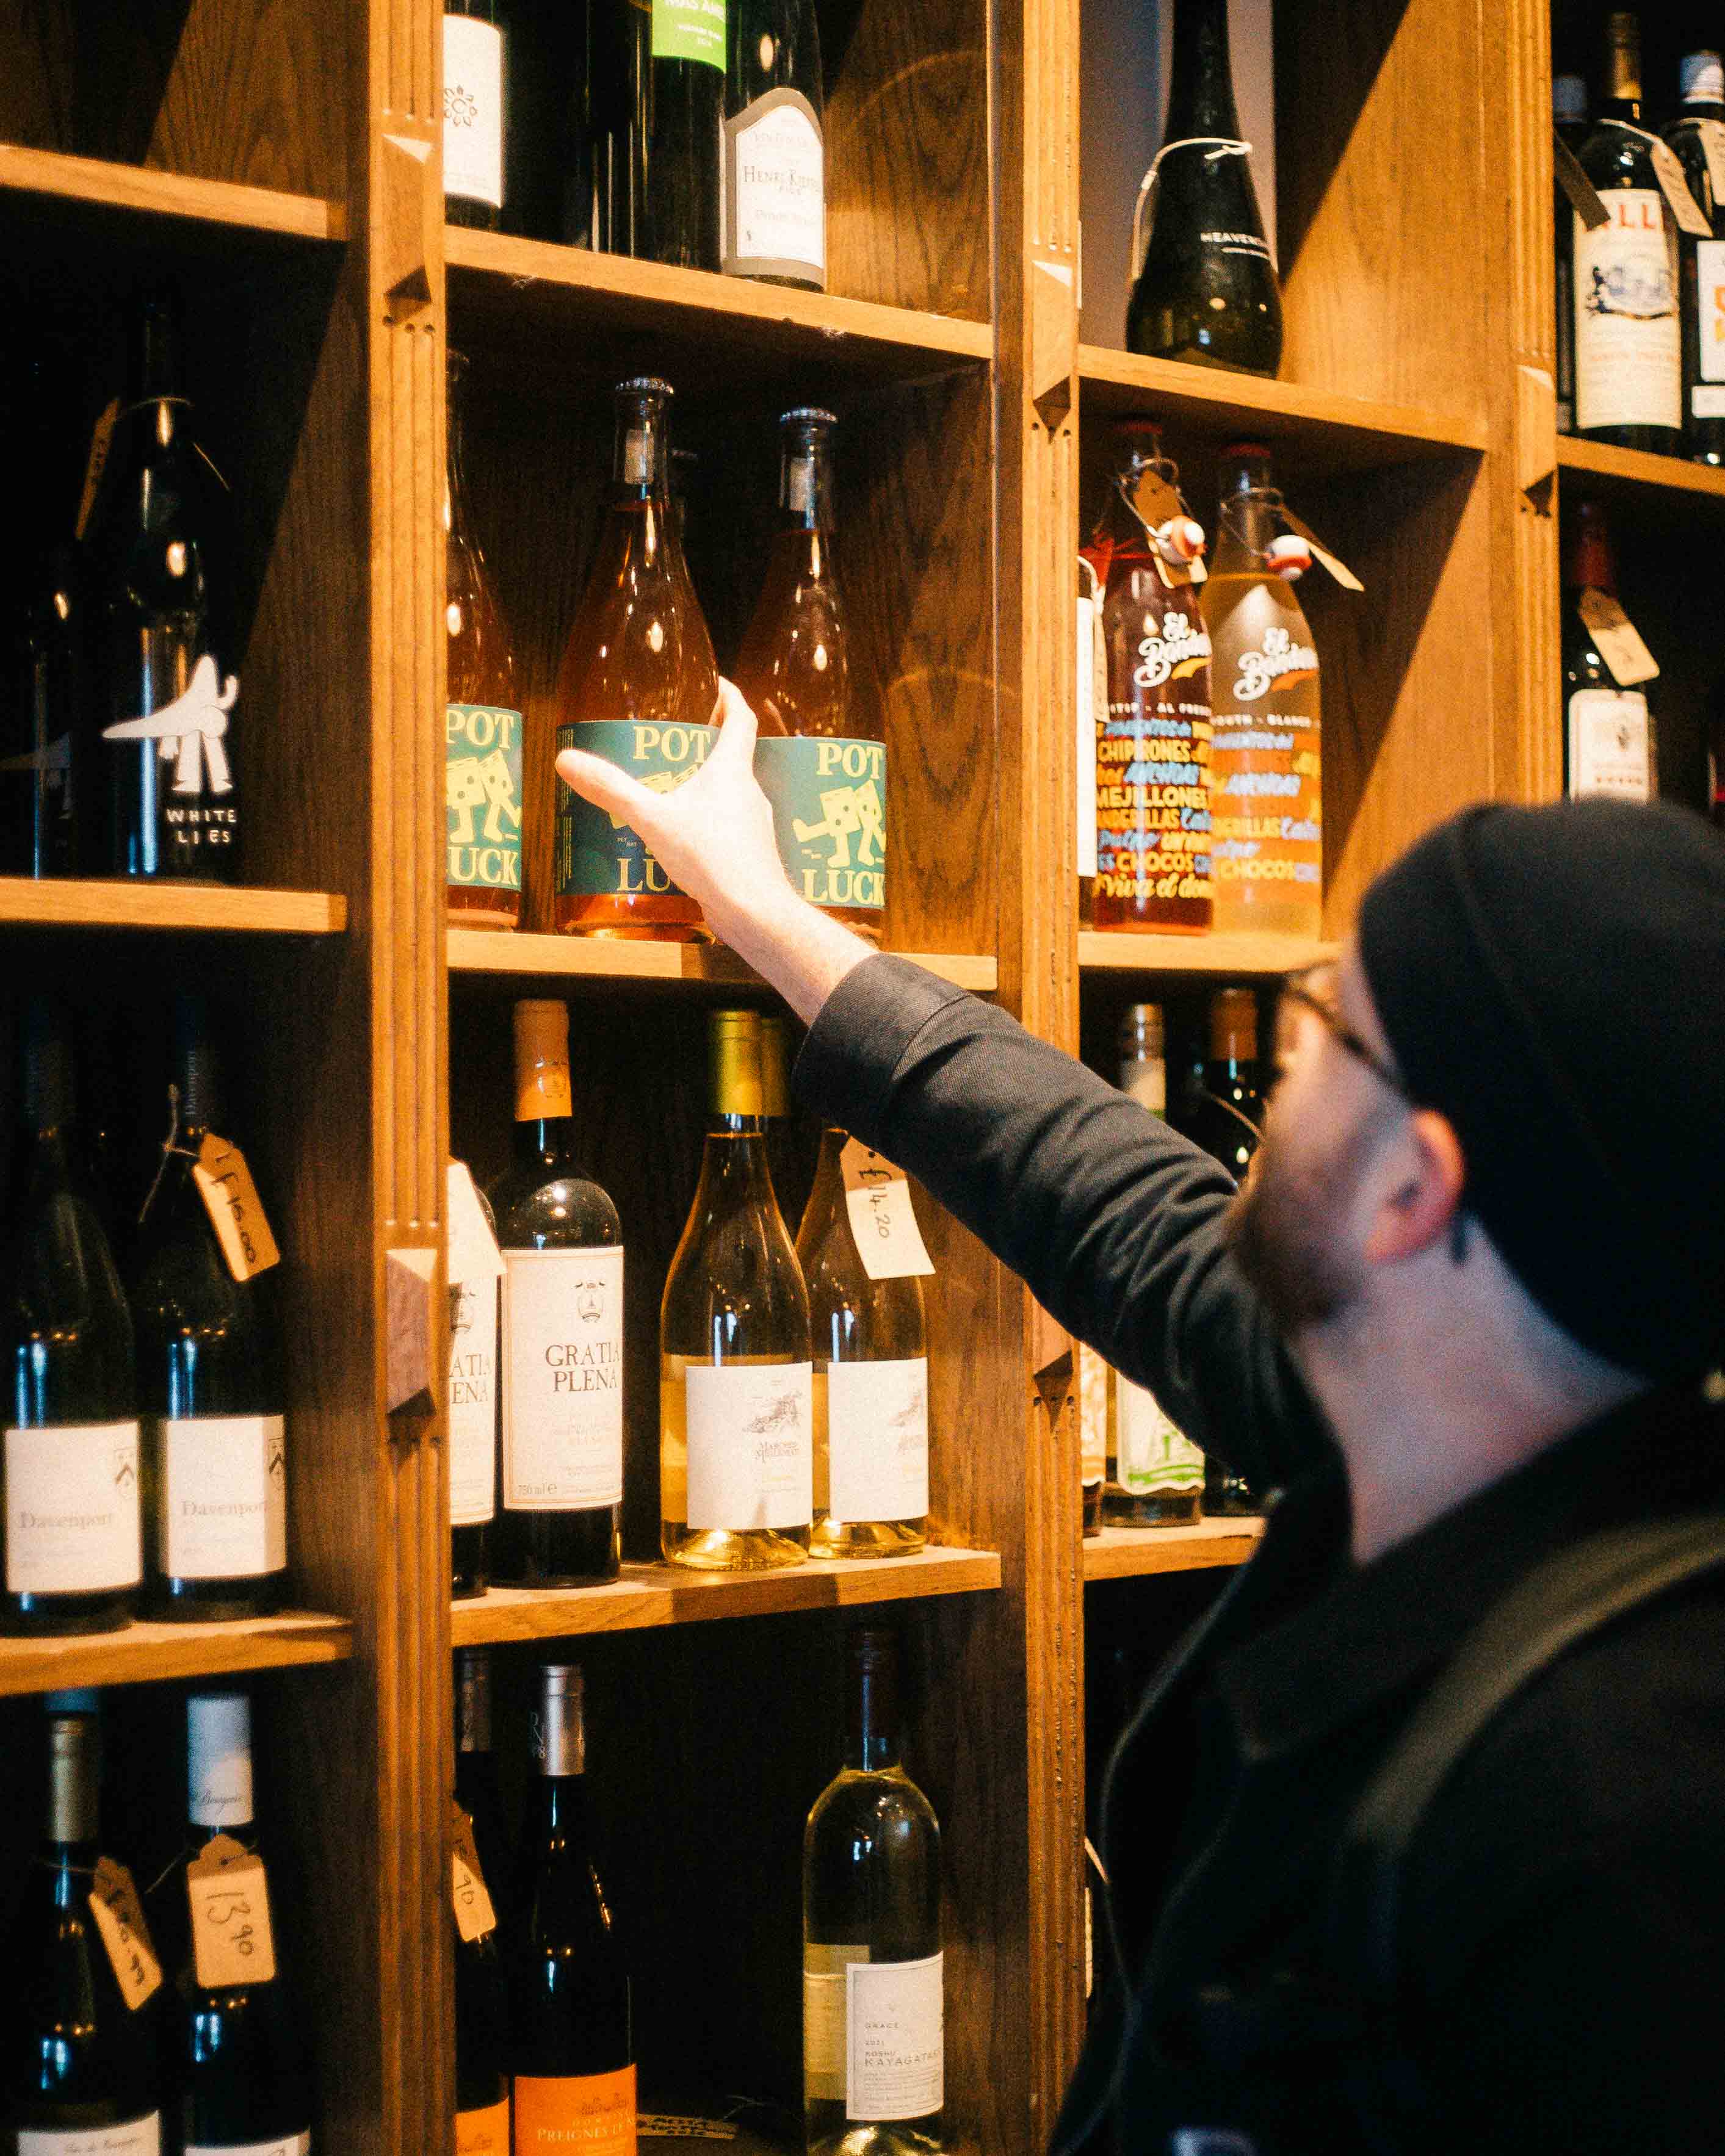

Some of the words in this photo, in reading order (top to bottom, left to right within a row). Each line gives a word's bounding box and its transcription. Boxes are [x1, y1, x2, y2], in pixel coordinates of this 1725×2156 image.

[446, 711, 514, 750] POT
[633, 726, 713, 763] POT
[816, 743, 883, 779] POT
[166, 809, 237, 823] WHITE
[177, 829, 231, 845] LIES
[447, 846, 518, 886] UCK
[617, 857, 671, 892] LU
[801, 868, 885, 906] LUCK
[859, 1168, 892, 1239] £14.20
[545, 1343, 621, 1367] GRATIA
[554, 1368, 618, 1393] PLENA
